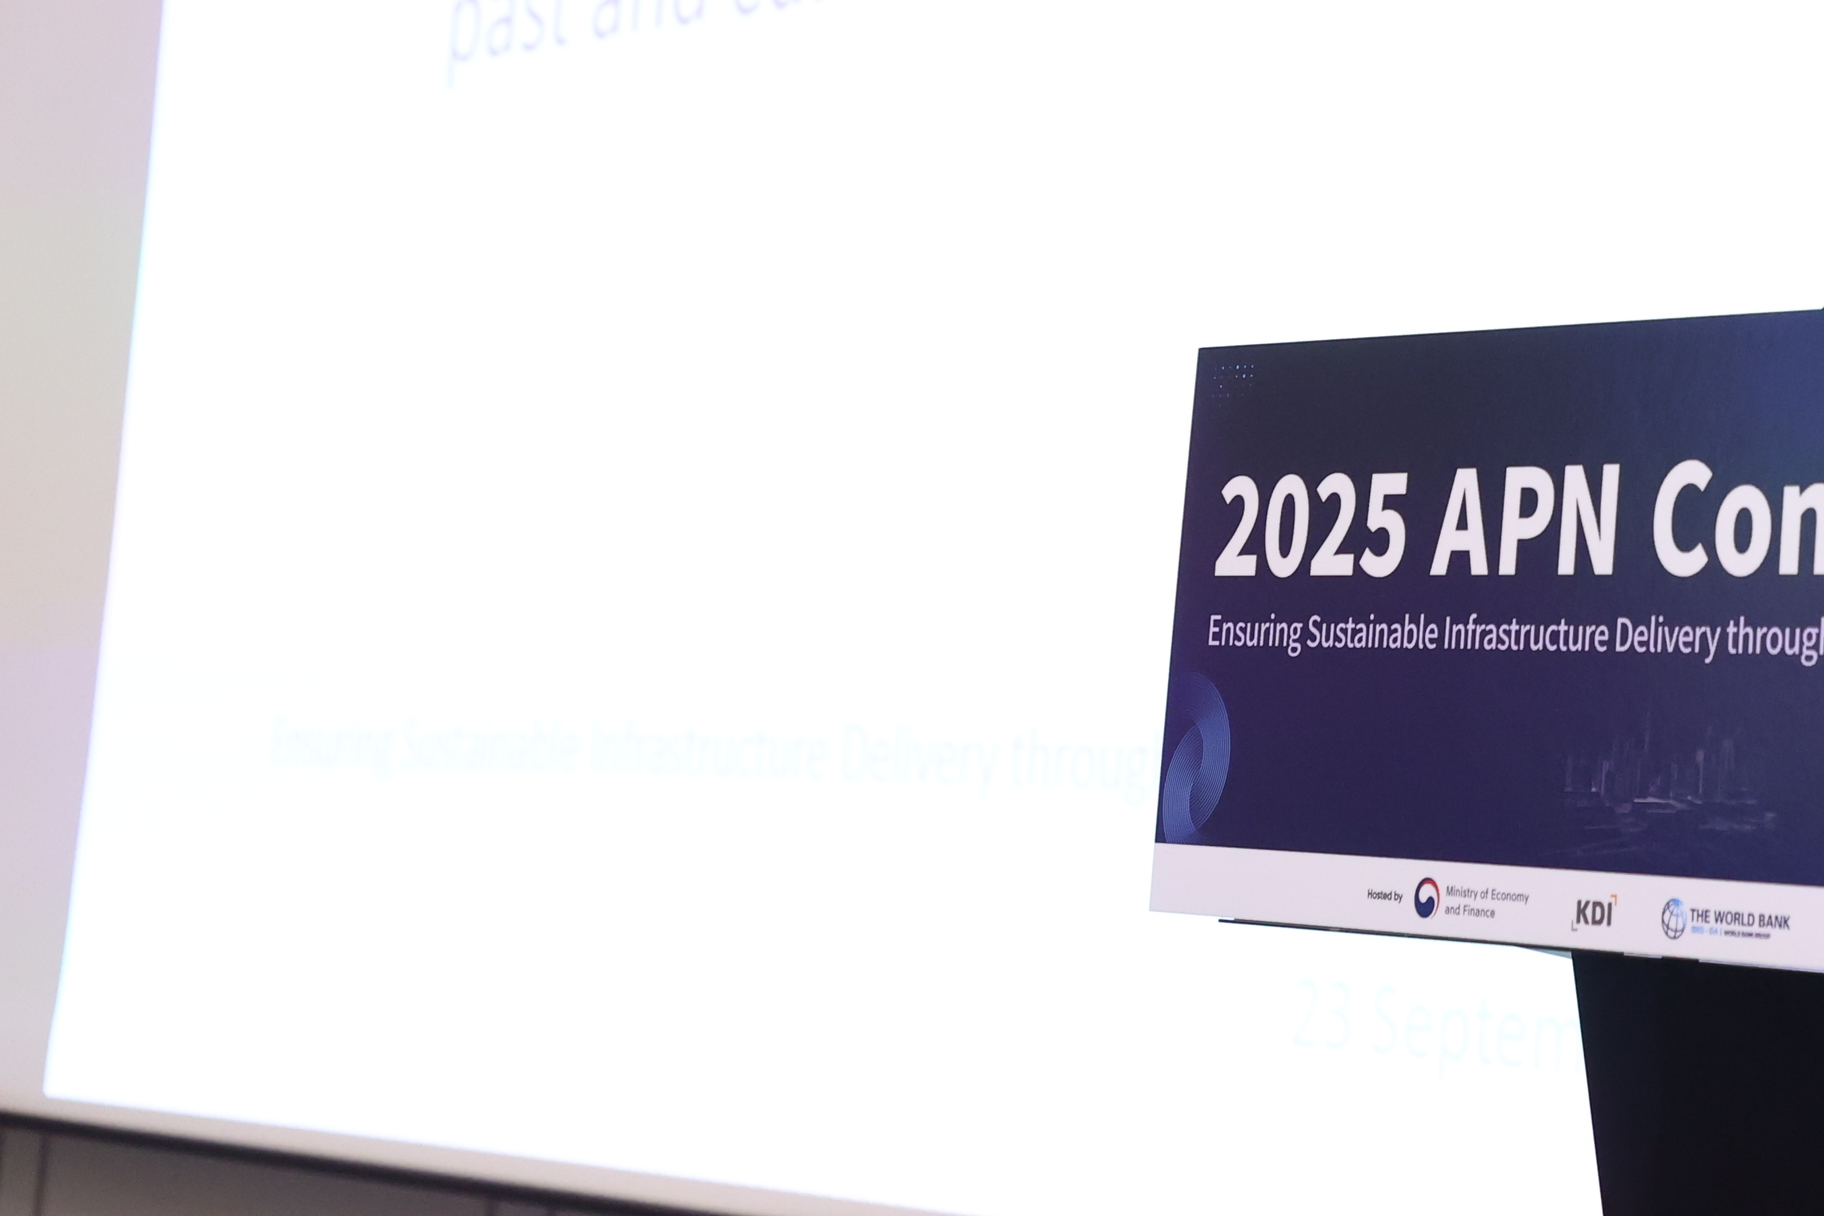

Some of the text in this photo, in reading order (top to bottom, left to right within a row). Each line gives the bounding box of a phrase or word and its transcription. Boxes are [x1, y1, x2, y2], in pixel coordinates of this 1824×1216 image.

[1214, 472, 1408, 578] 2025
[1429, 464, 1620, 576] APN
[1208, 613, 1302, 657] Ensuring
[1306, 614, 1438, 650] Sustainable
[1443, 613, 1609, 653] Infrastructure
[1615, 616, 1719, 664] Delivery
[590, 716, 830, 781] Infrastructure
[840, 723, 1001, 800] Delivery
[1367, 888, 1403, 903] Hosted by
[1446, 885, 1529, 904] Ministry of Economy
[1444, 904, 1495, 918] and Finance
[1576, 899, 1613, 927] KDI
[1690, 908, 1790, 930] THE WORLD BANK
[1292, 977, 1353, 1051] 23
